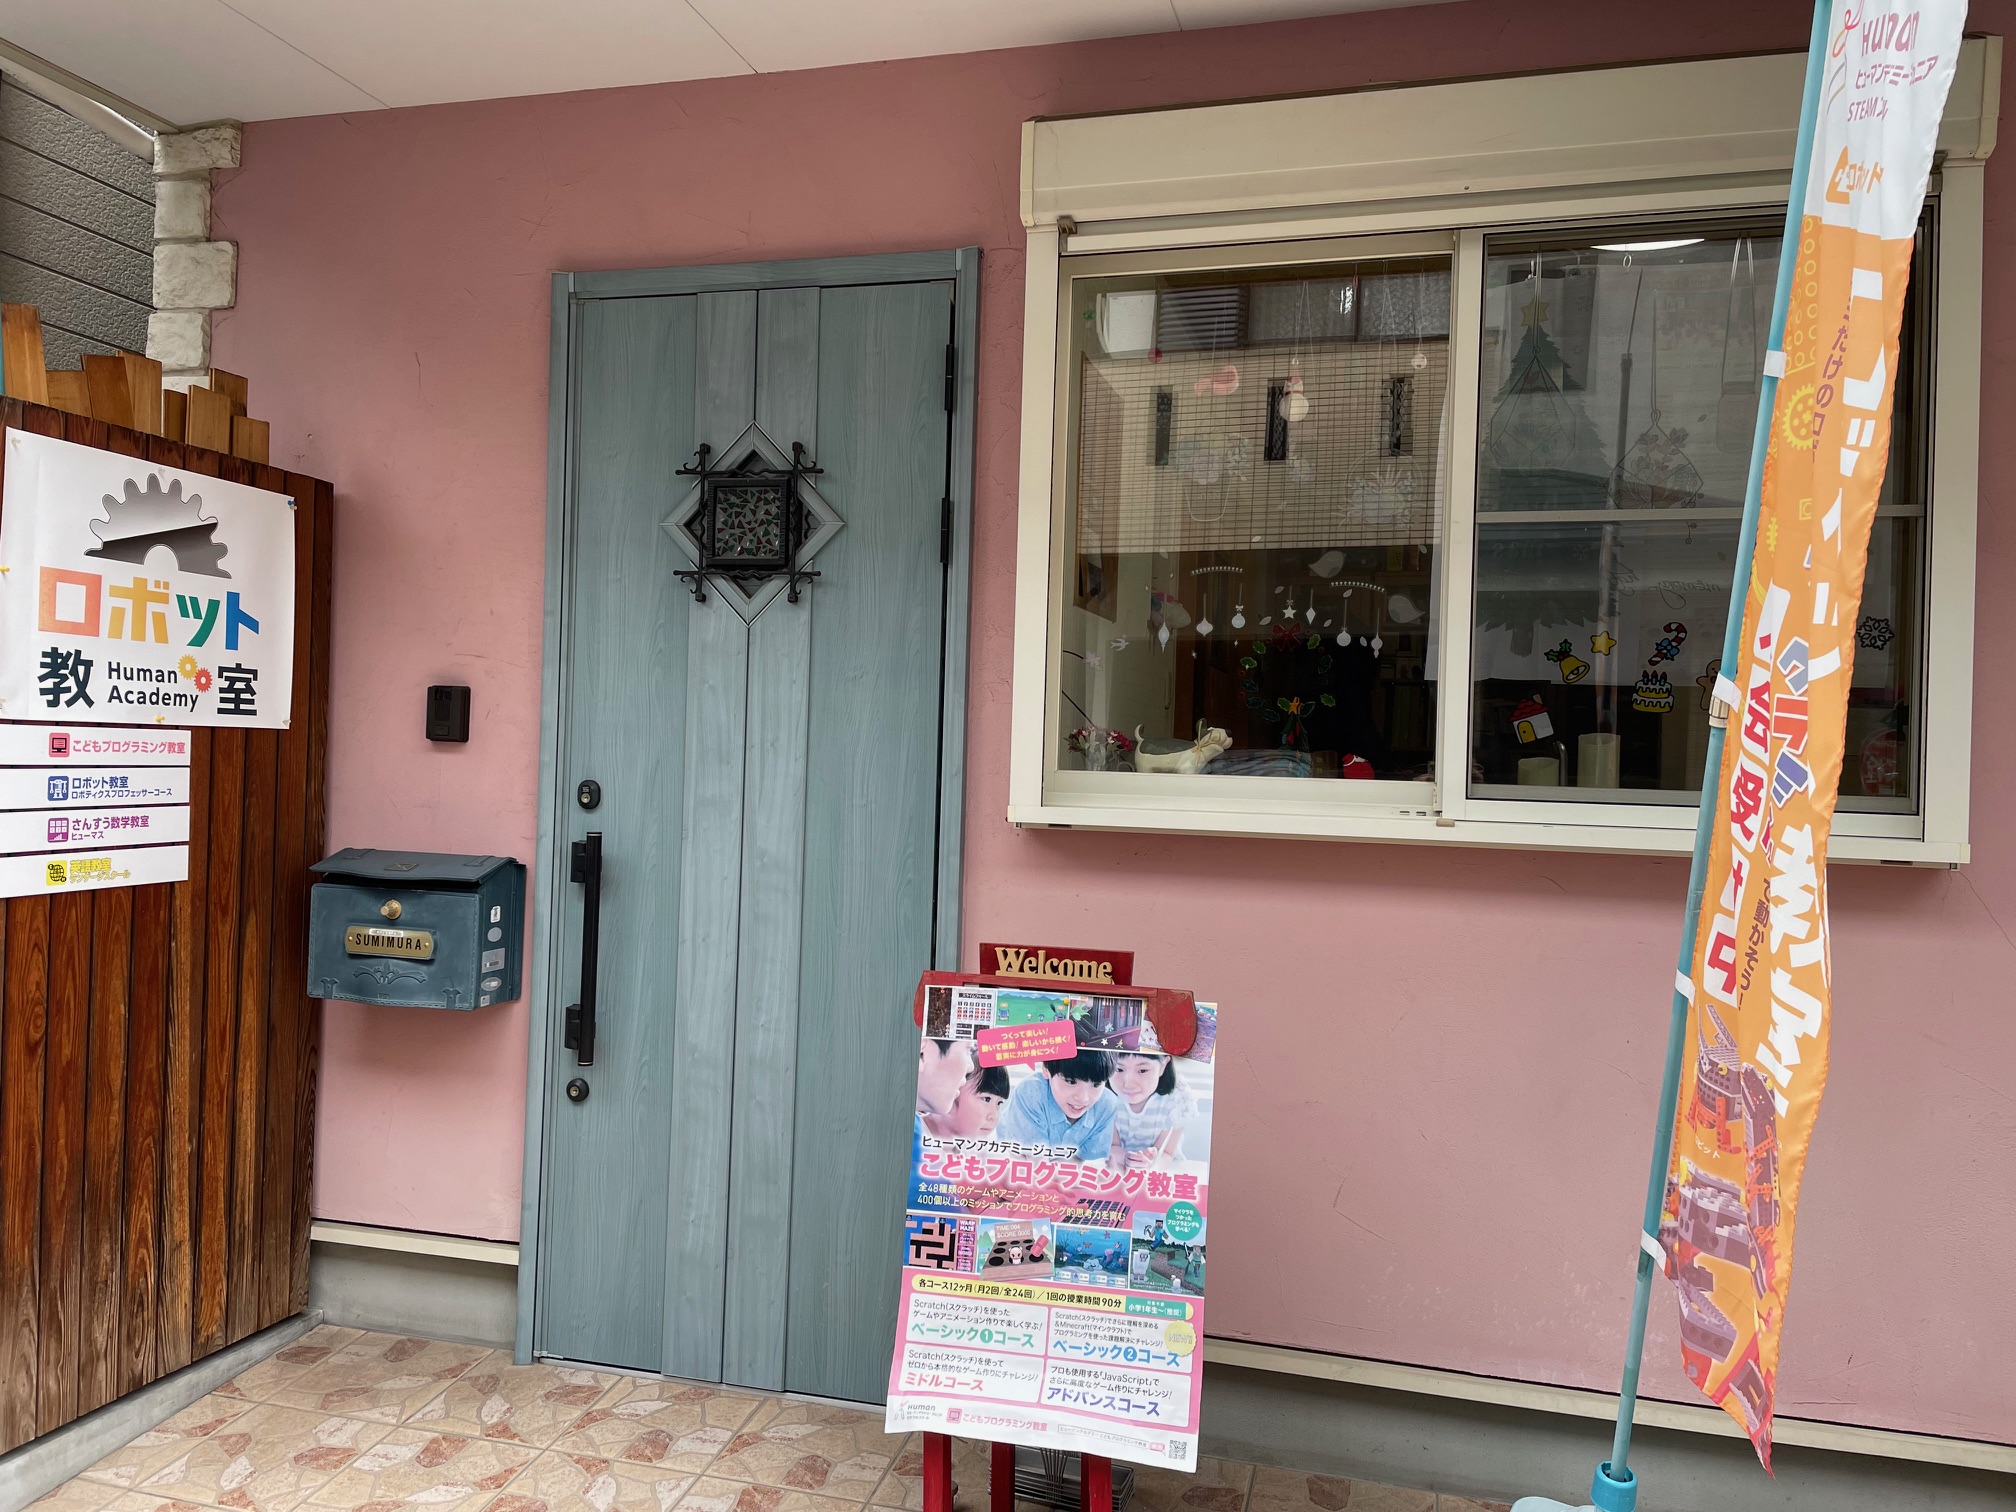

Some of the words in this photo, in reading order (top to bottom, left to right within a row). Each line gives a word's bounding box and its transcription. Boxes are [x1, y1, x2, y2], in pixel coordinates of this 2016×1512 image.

[38, 566, 260, 651] ロボット
[108, 661, 178, 684] Human
[107, 685, 199, 712] Academy
[73, 740, 186, 754] こどもプログラミング教室
[72, 776, 129, 790] ロボット教室
[71, 788, 172, 800] ロボティクスプロフェッサーコース
[72, 815, 150, 831] さんすう数学教室
[71, 831, 105, 841] ヒューマス
[355, 933, 422, 951] SUMIMURA
[994, 946, 1113, 980] Welcome
[921, 1135, 1078, 1158] ヒューマンアカデミージュニア
[918, 1152, 1199, 1201] こどもプログラミング教室
[917, 1182, 1060, 1203] 全48種類のゲームやアニメーションと
[917, 1194, 1126, 1221] 400個以上のミッションでプログラミング的思考力を育む
[914, 1299, 1011, 1316] Scratch(スクラッチ)を使った
[912, 1310, 1043, 1331] ゲームやアニメーション作りで楽しく学ぶ!
[908, 1349, 1005, 1368] Scratch(スクラッチ)を使って
[905, 1371, 984, 1391] ミドルコース
[1047, 1387, 1160, 1417] アドバンスコース
[963, 1413, 1048, 1432] こどもプログラミング教室
